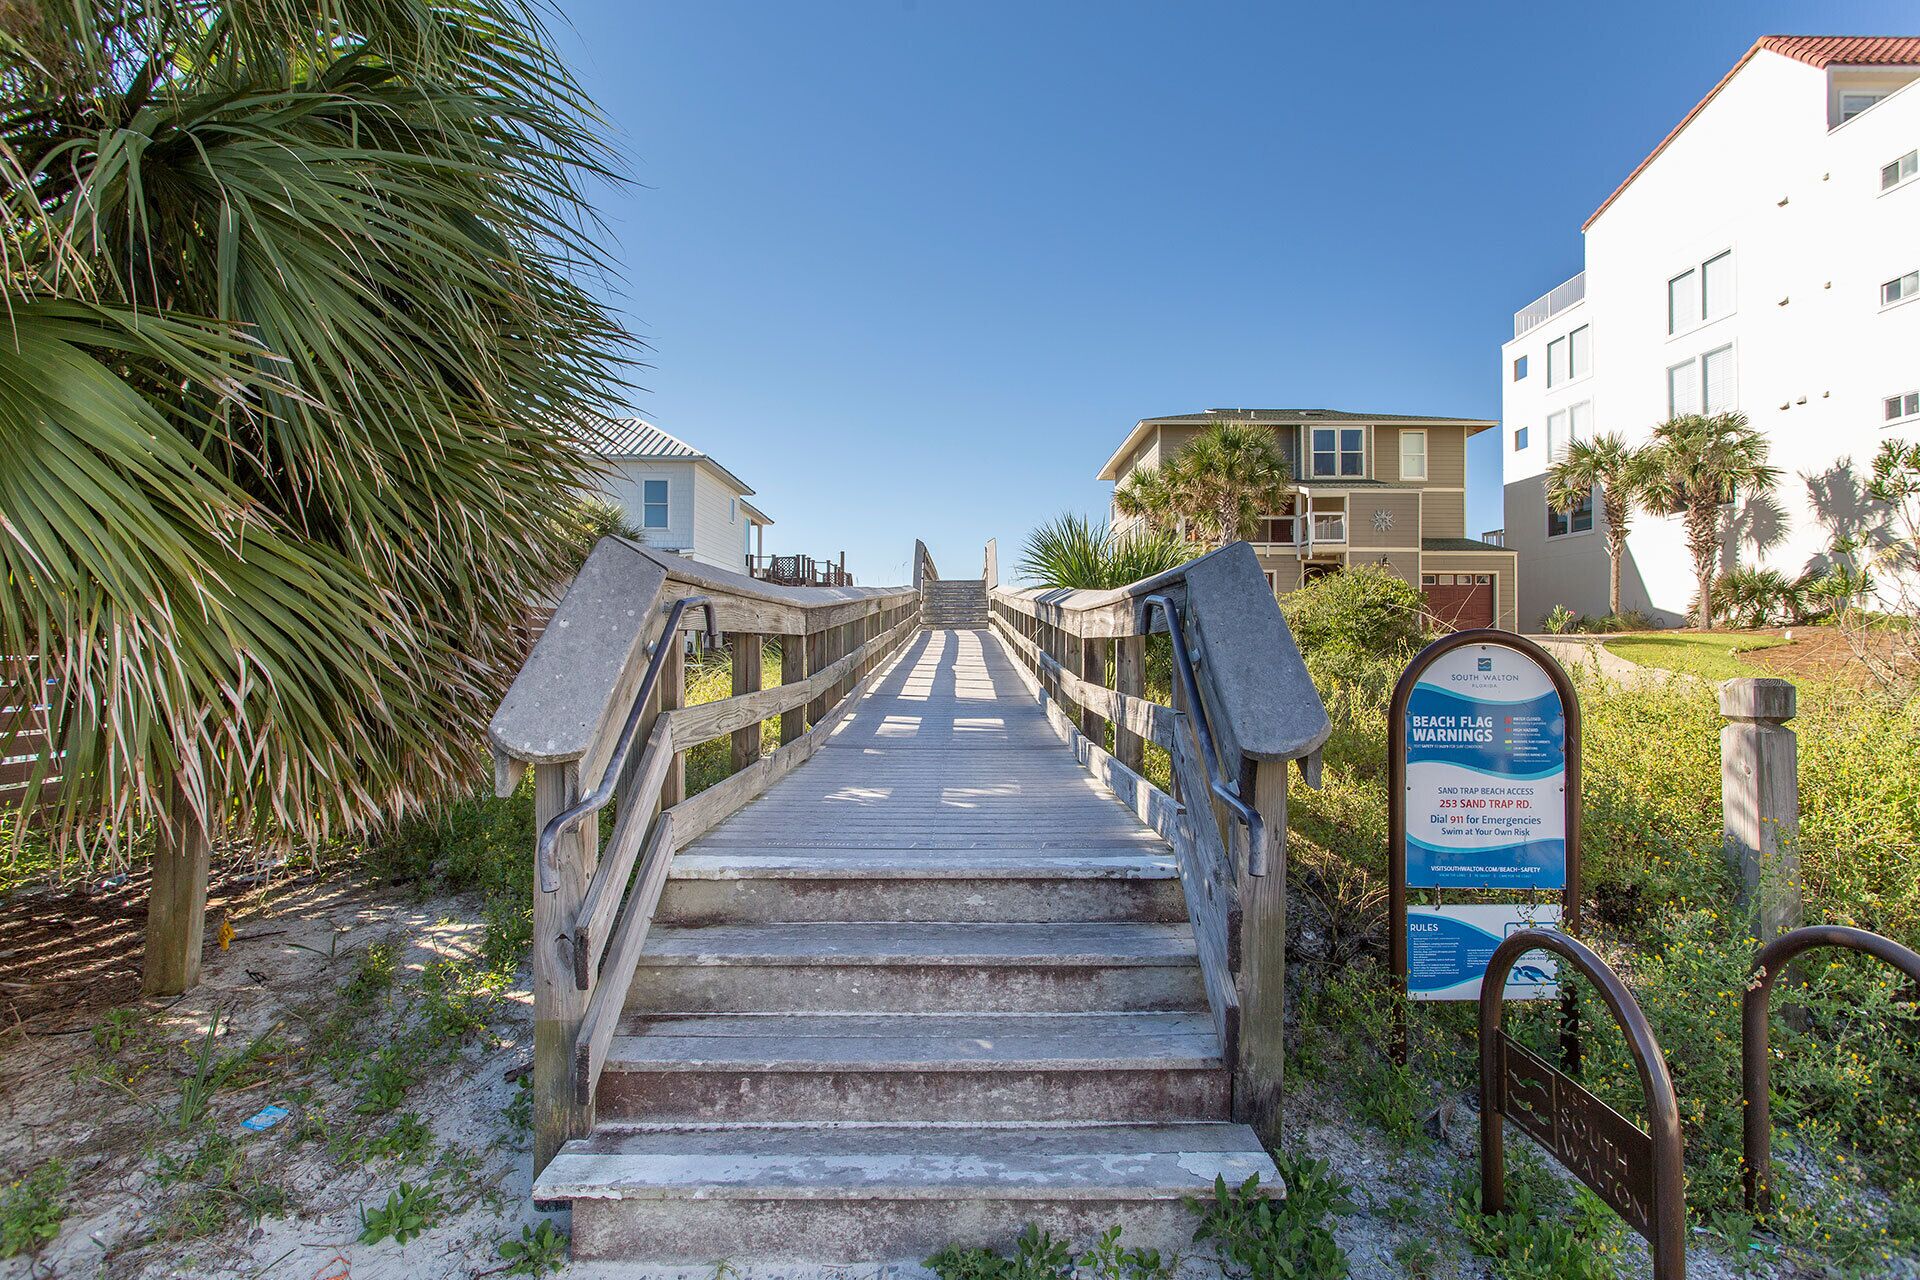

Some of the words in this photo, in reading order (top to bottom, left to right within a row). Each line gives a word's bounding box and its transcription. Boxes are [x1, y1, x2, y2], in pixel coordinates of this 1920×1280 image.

[1451, 673, 1479, 682] SOUTH
[1483, 674, 1519, 682] WALTON
[1412, 716, 1456, 727] BEACH
[1460, 716, 1493, 728] FLAG
[1412, 728, 1493, 742] WARNINGS
[1437, 786, 1459, 795] SAND
[1460, 787, 1479, 795] TRAP
[1480, 787, 1507, 796] BEACH
[1507, 787, 1534, 796] ACCESS
[1439, 799, 1458, 808] 253
[1459, 799, 1487, 809] SAND
[1488, 800, 1514, 809] TRAP
[1515, 800, 1532, 809] RD.
[1430, 814, 1448, 824] Dial
[1450, 815, 1464, 824] 911
[1466, 814, 1479, 824] for
[1481, 815, 1542, 827] Emergencies
[1441, 827, 1463, 835] Swim
[1465, 828, 1473, 836] at
[1475, 828, 1492, 836] Your
[1494, 828, 1512, 836] Own
[1514, 828, 1530, 837] Risk
[1430, 865, 1541, 873] VISITSOUTHWALTON.COM/BEACH-SAFETY
[1409, 923, 1439, 932] RULES
[1561, 1107, 1628, 1177] SOUTH
[1561, 1134, 1648, 1227] WALTON
